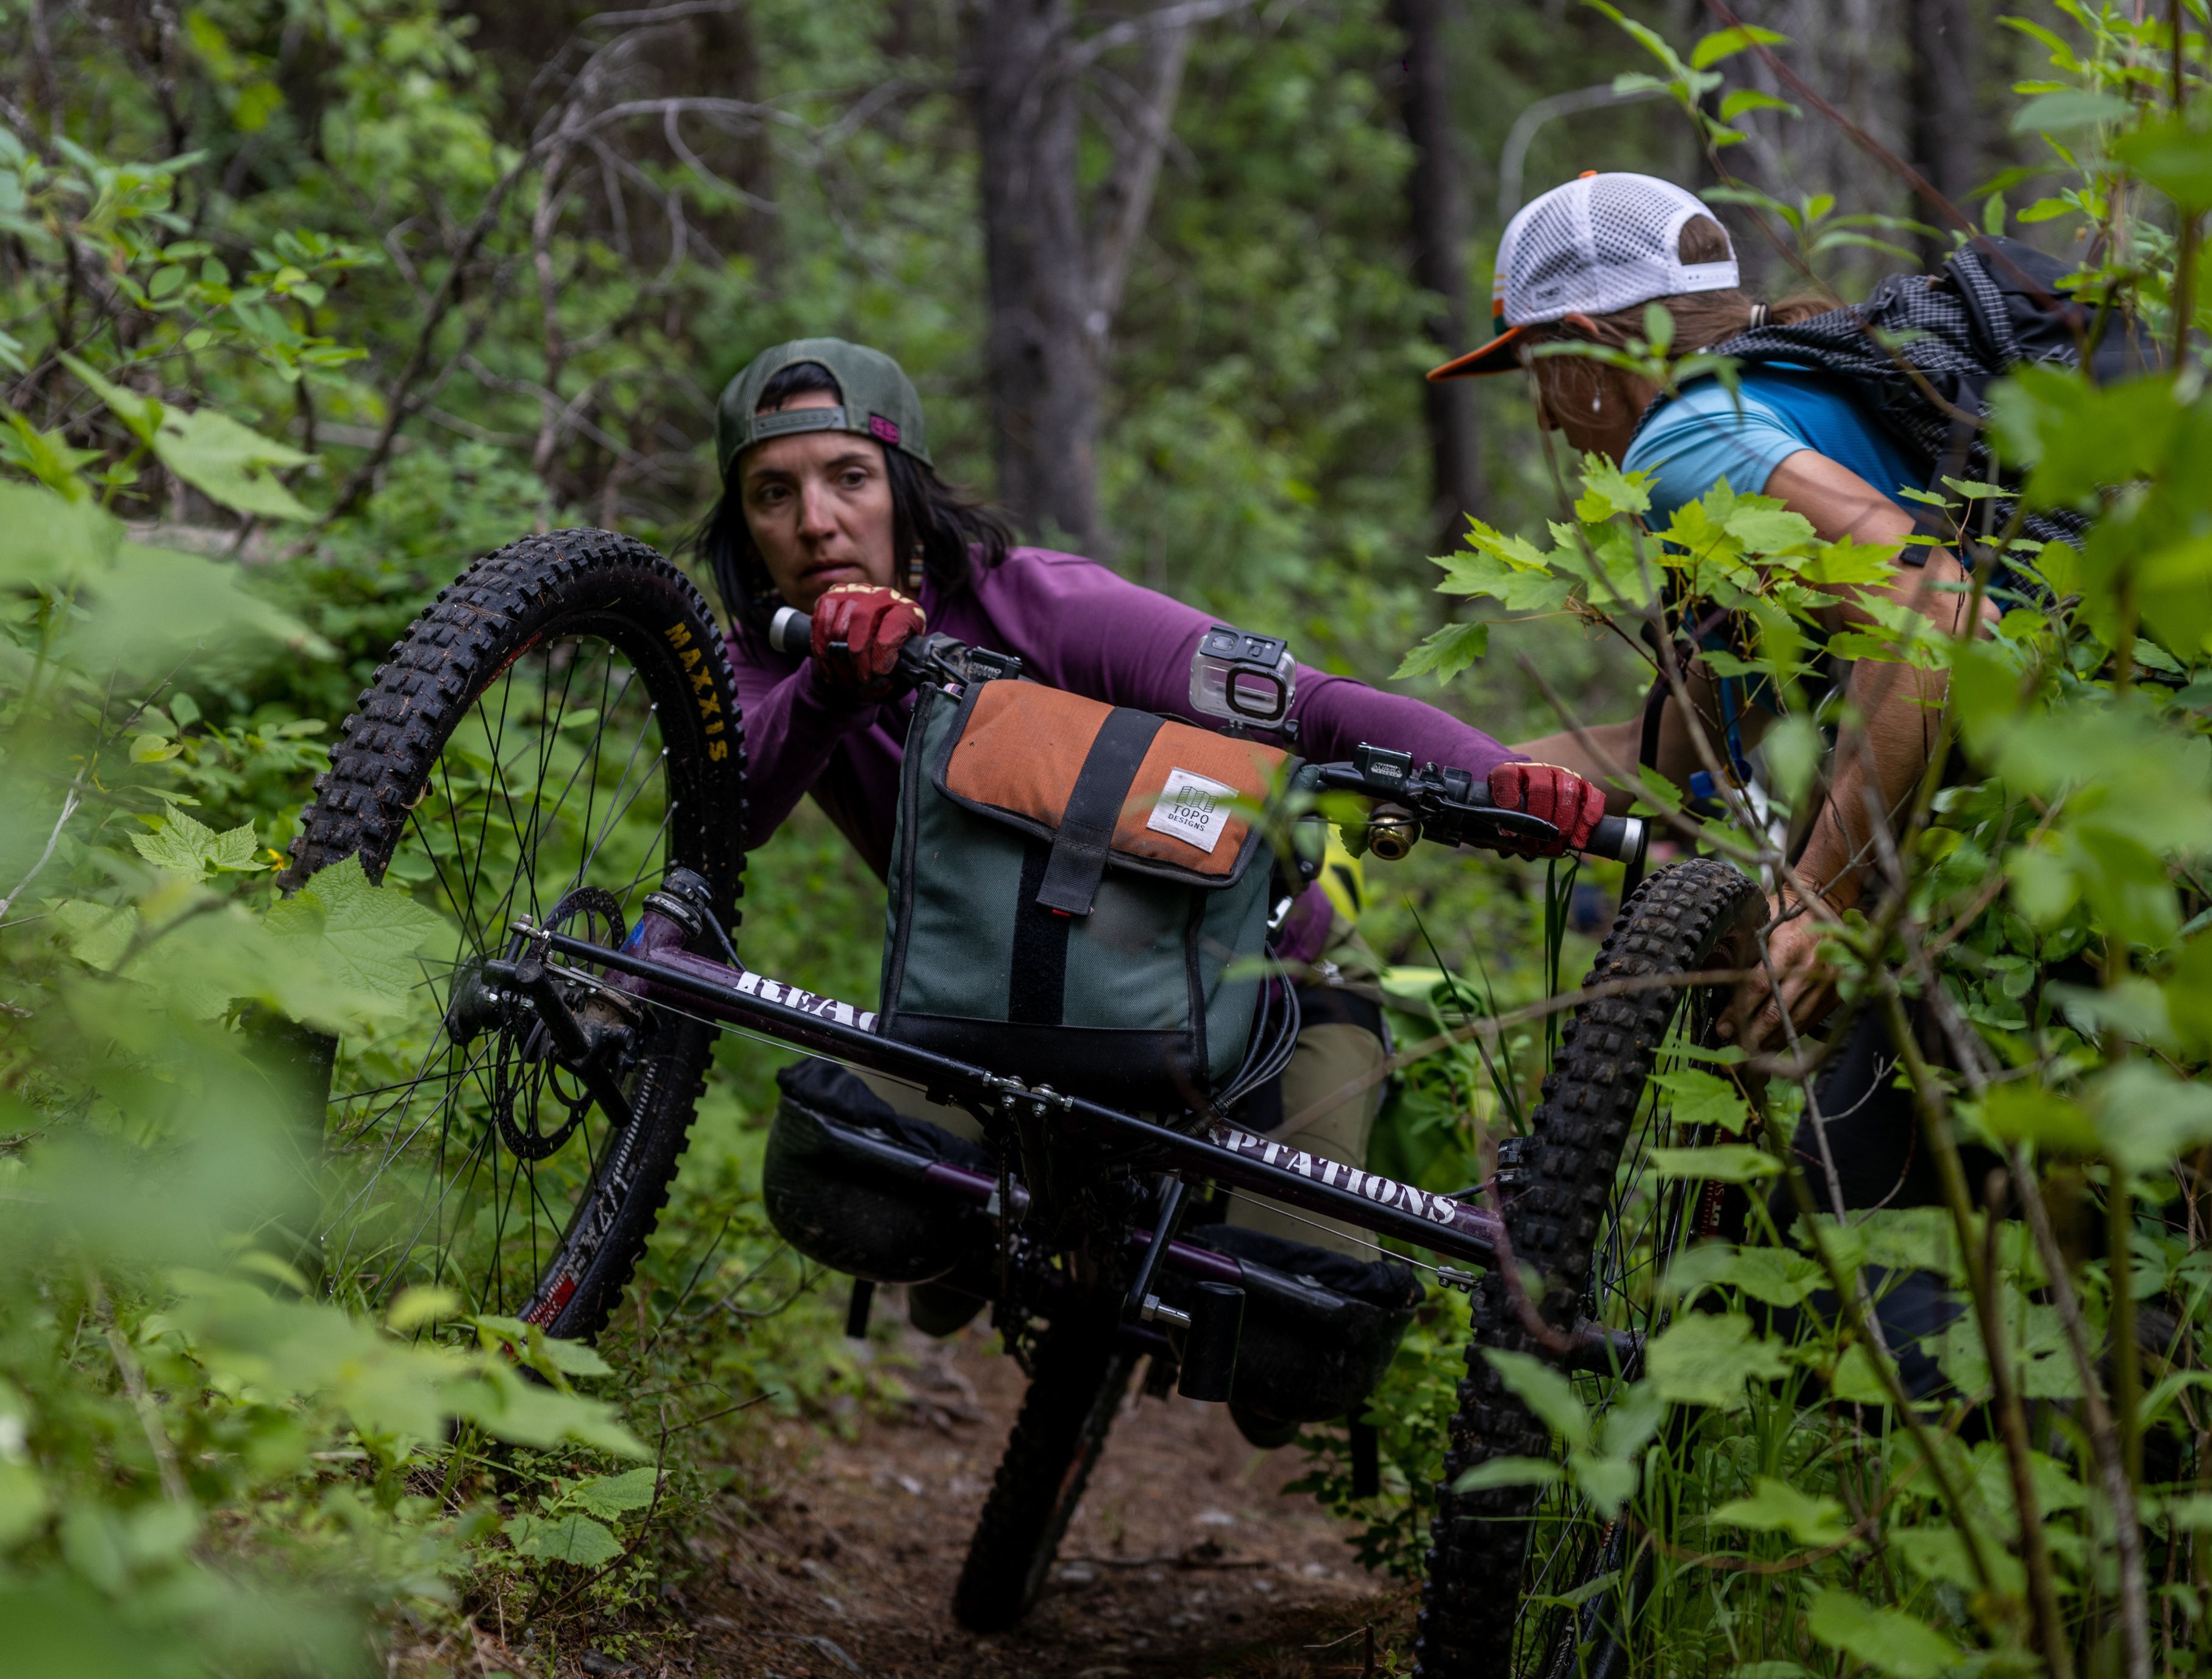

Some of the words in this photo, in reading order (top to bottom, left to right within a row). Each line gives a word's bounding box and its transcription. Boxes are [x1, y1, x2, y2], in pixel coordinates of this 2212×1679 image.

[664, 621, 728, 761] MAXXIS
[1168, 813, 1206, 832] DESIGNS
[1173, 804, 1209, 825] TOPO
[1209, 1128, 1458, 1224] PTATIONS
